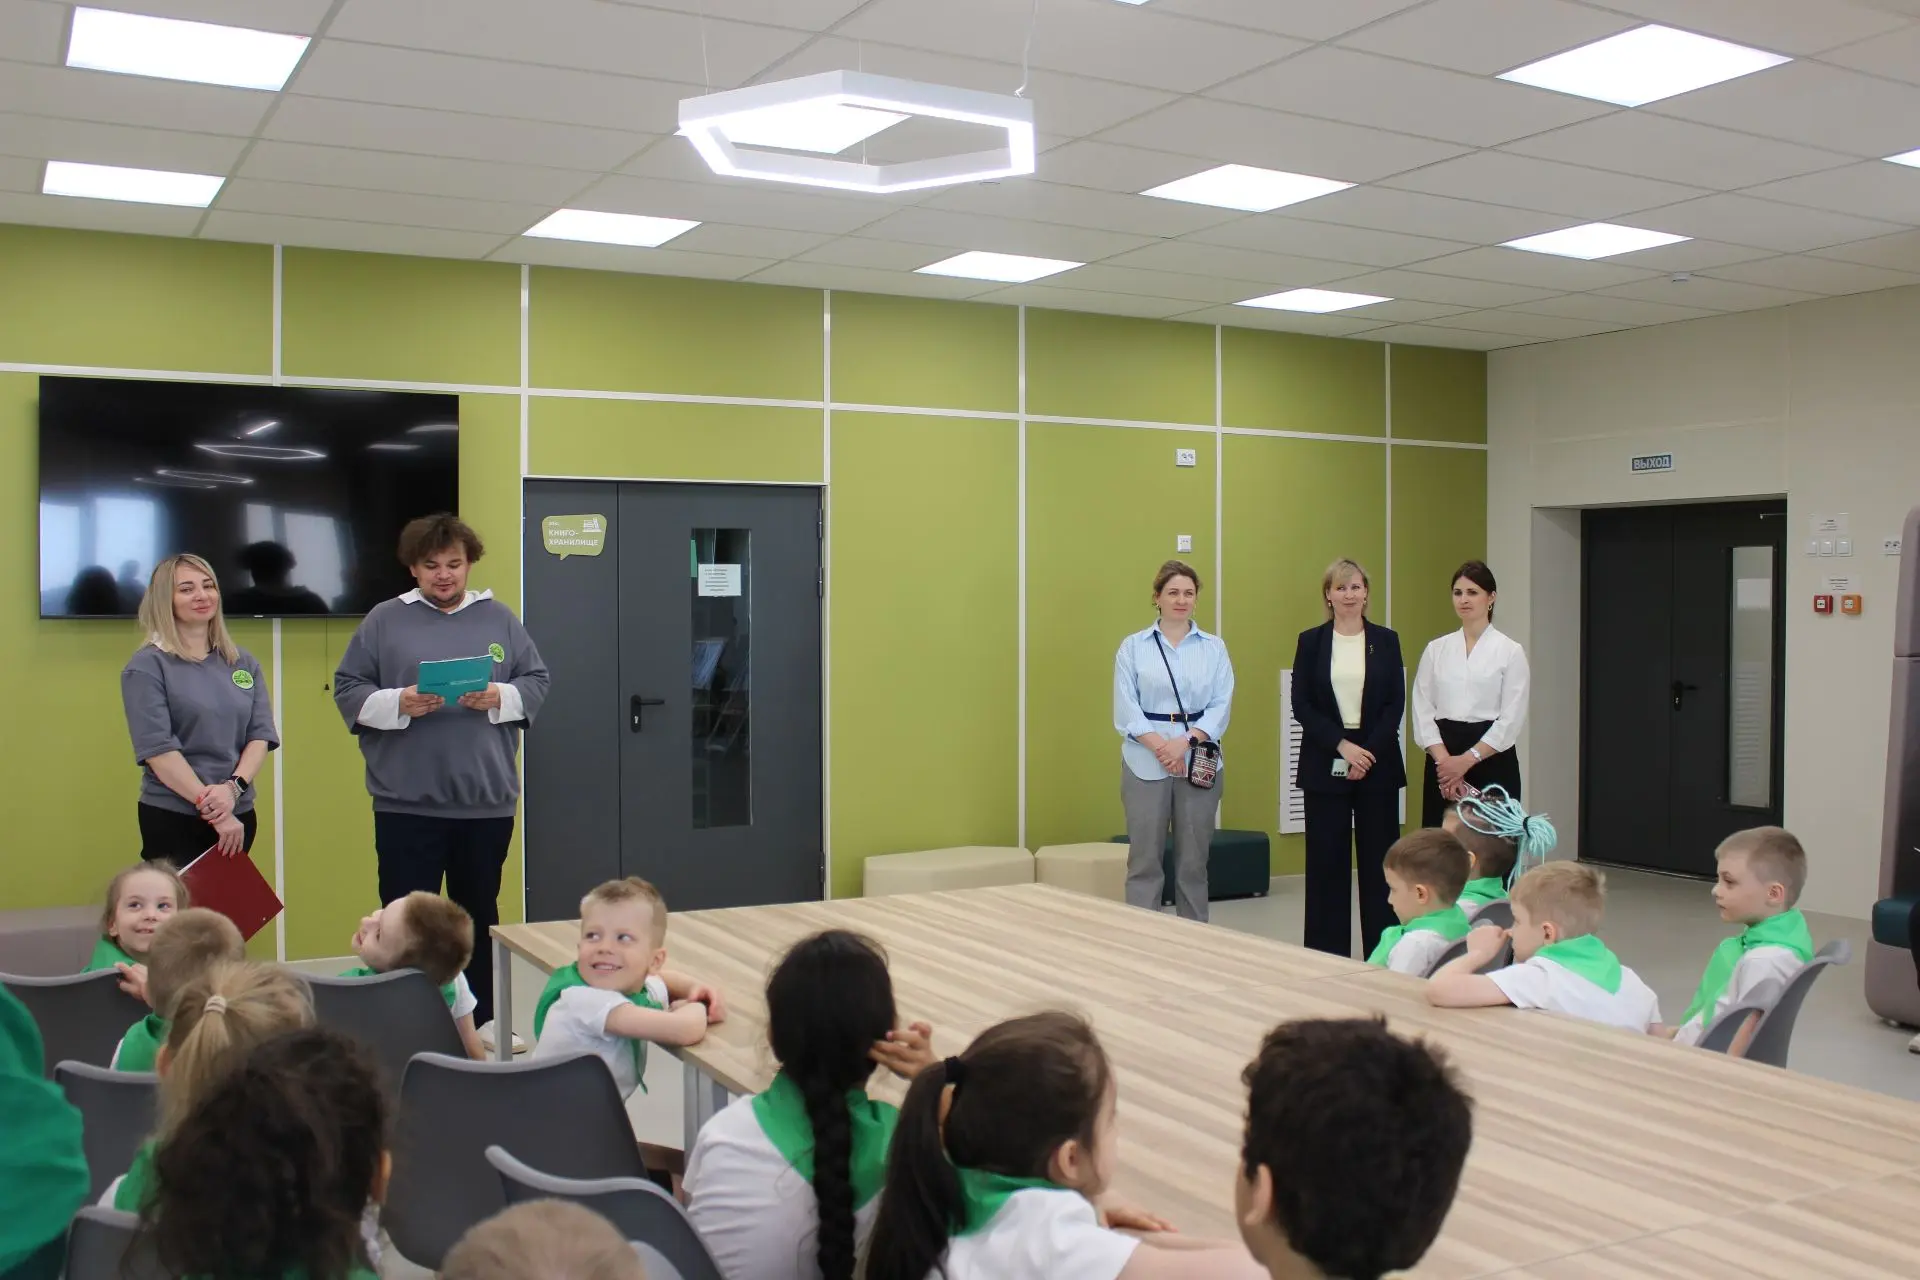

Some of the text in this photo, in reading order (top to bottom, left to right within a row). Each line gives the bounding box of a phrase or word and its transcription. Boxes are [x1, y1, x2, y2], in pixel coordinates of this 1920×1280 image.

[1633, 456, 1670, 469] ВЫХОД
[548, 529, 579, 537] КНИГО-
[548, 538, 600, 546] ХРАНИЛИЩЕ
